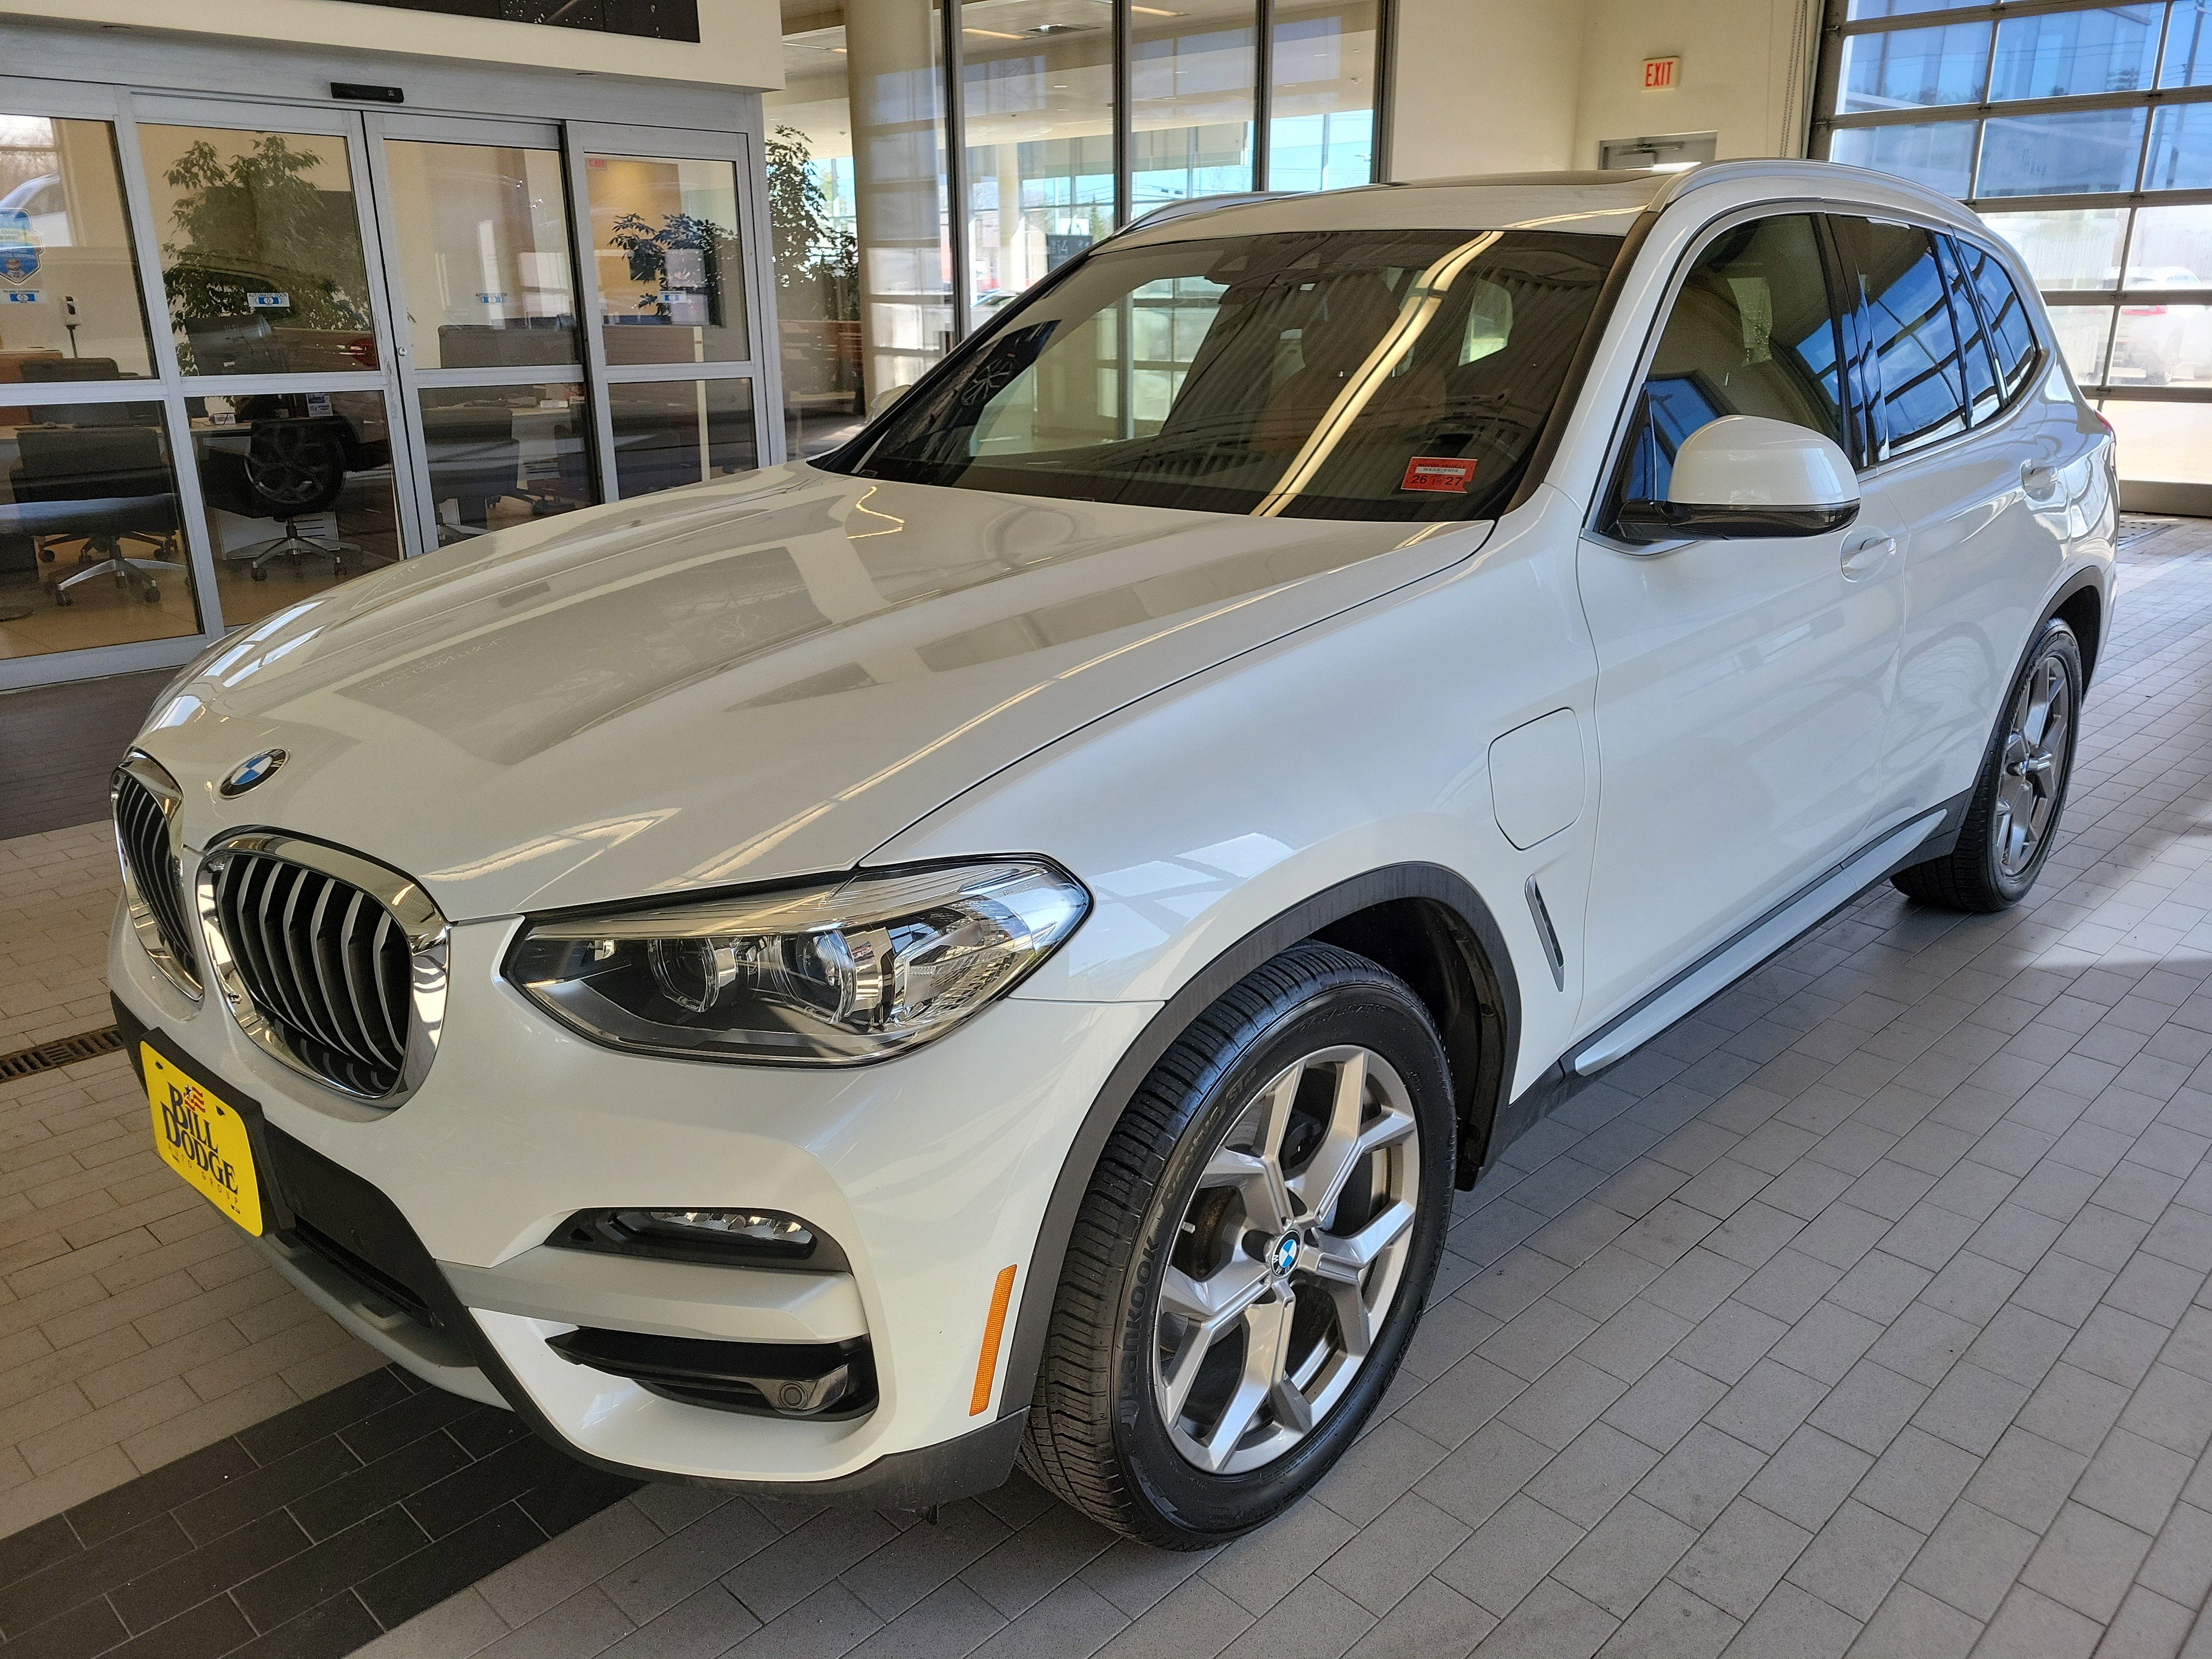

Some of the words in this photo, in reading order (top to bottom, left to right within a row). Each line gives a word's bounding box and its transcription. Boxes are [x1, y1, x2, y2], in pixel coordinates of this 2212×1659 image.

[1645, 61, 1673, 86] EXIT
[1411, 475, 1428, 484] 26
[1444, 476, 1463, 486] 27
[167, 1081, 219, 1154] BILL
[160, 1101, 239, 1195] DODGE
[168, 1143, 193, 1169] AUTO
[201, 1171, 238, 1205] GROUP
[1273, 1254, 1291, 1275] BMW
